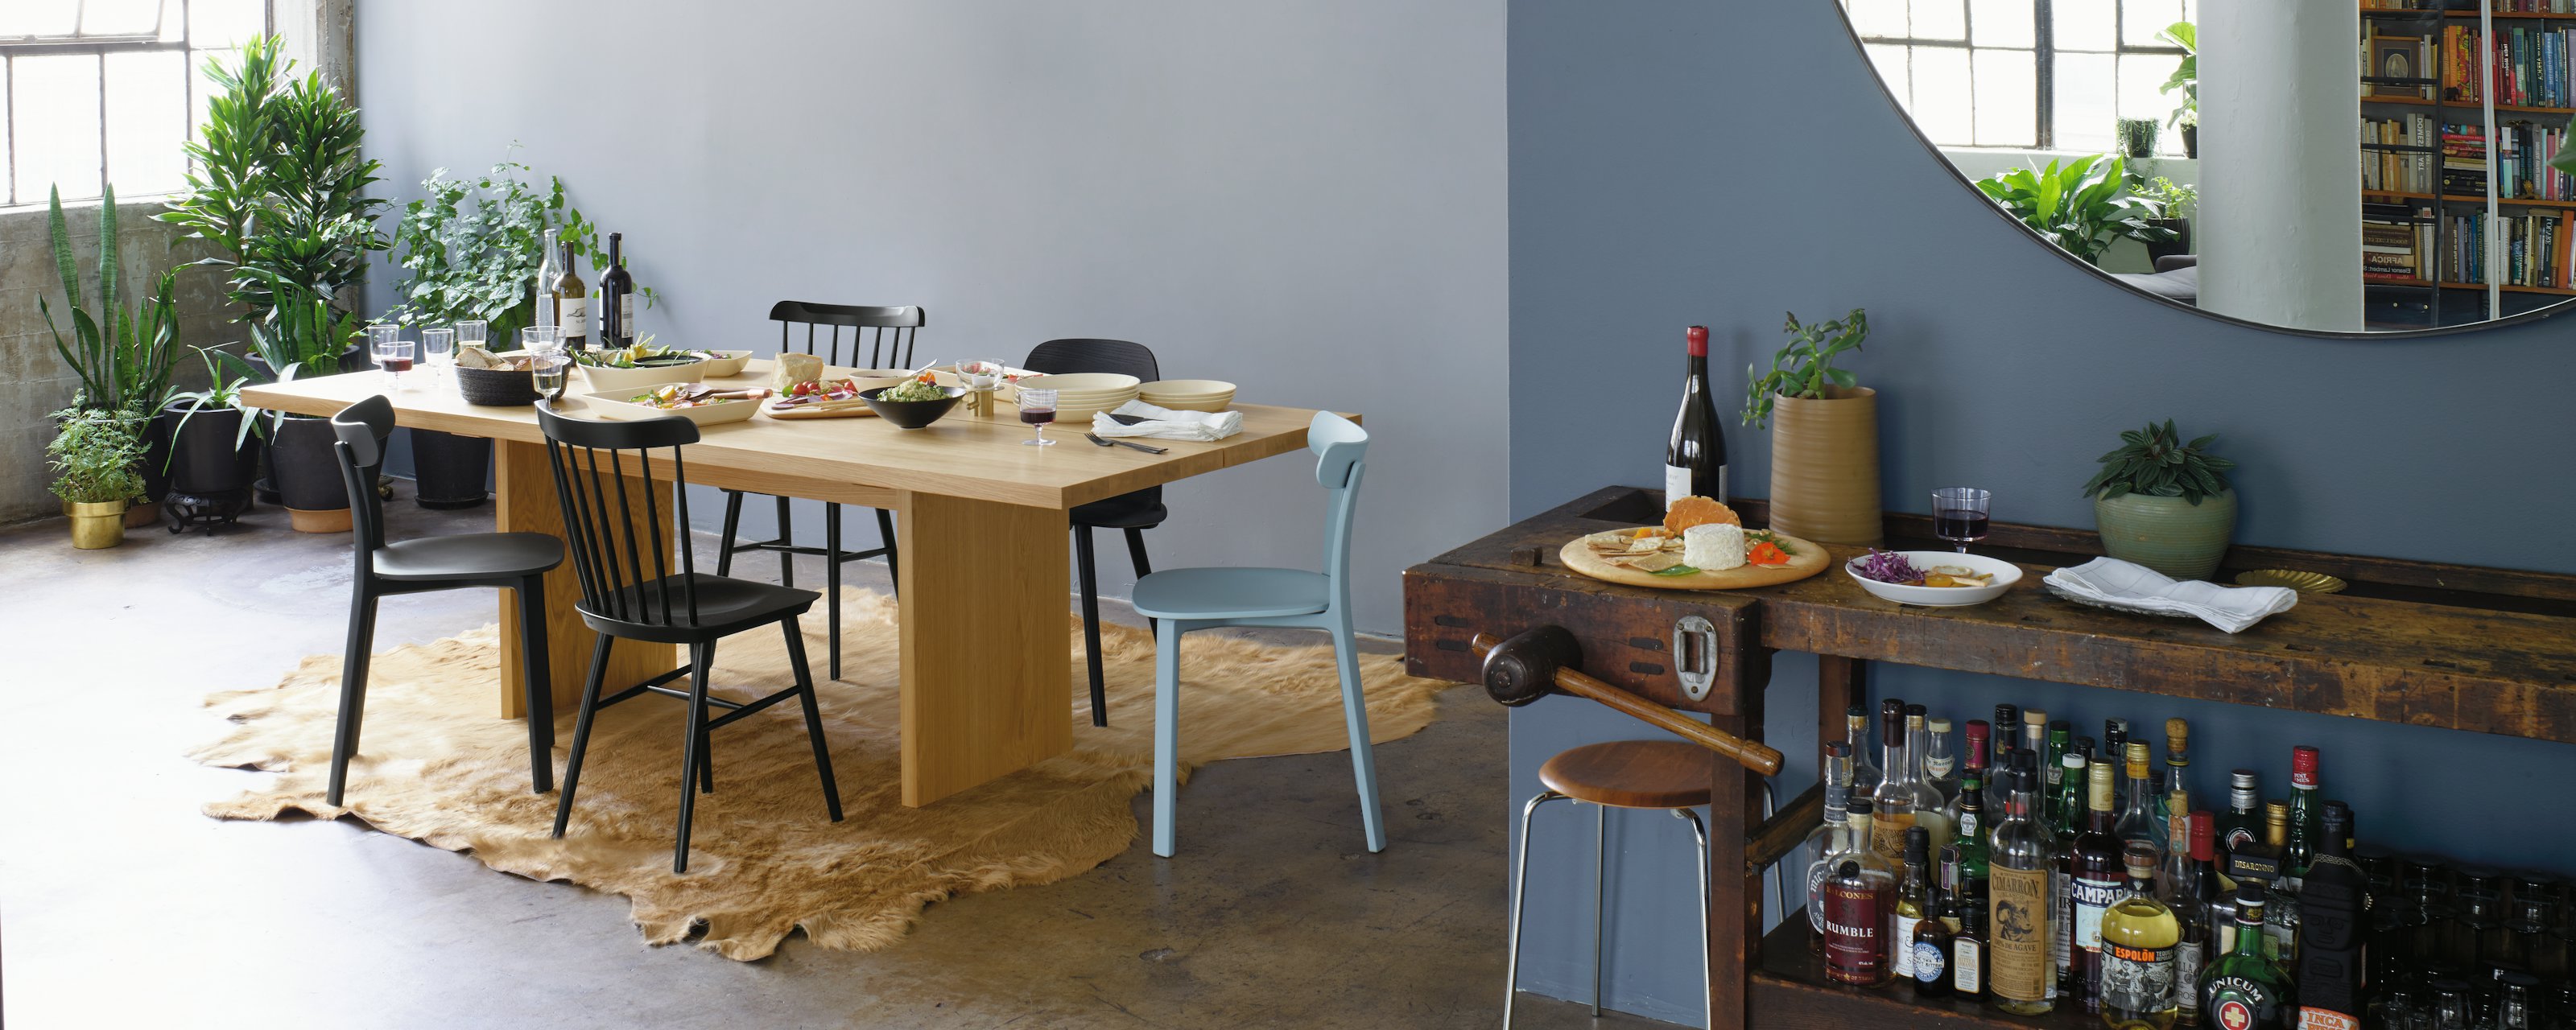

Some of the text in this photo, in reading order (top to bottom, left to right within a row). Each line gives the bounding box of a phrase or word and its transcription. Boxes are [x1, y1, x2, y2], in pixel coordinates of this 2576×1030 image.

[2234, 859, 2275, 873] DISARONNO
[1992, 873, 2039, 899] CIMARRON
[1826, 920, 1874, 938] RUMBLE
[2208, 976, 2264, 1002] UNICUM
[2306, 1012, 2345, 1029] INCA
